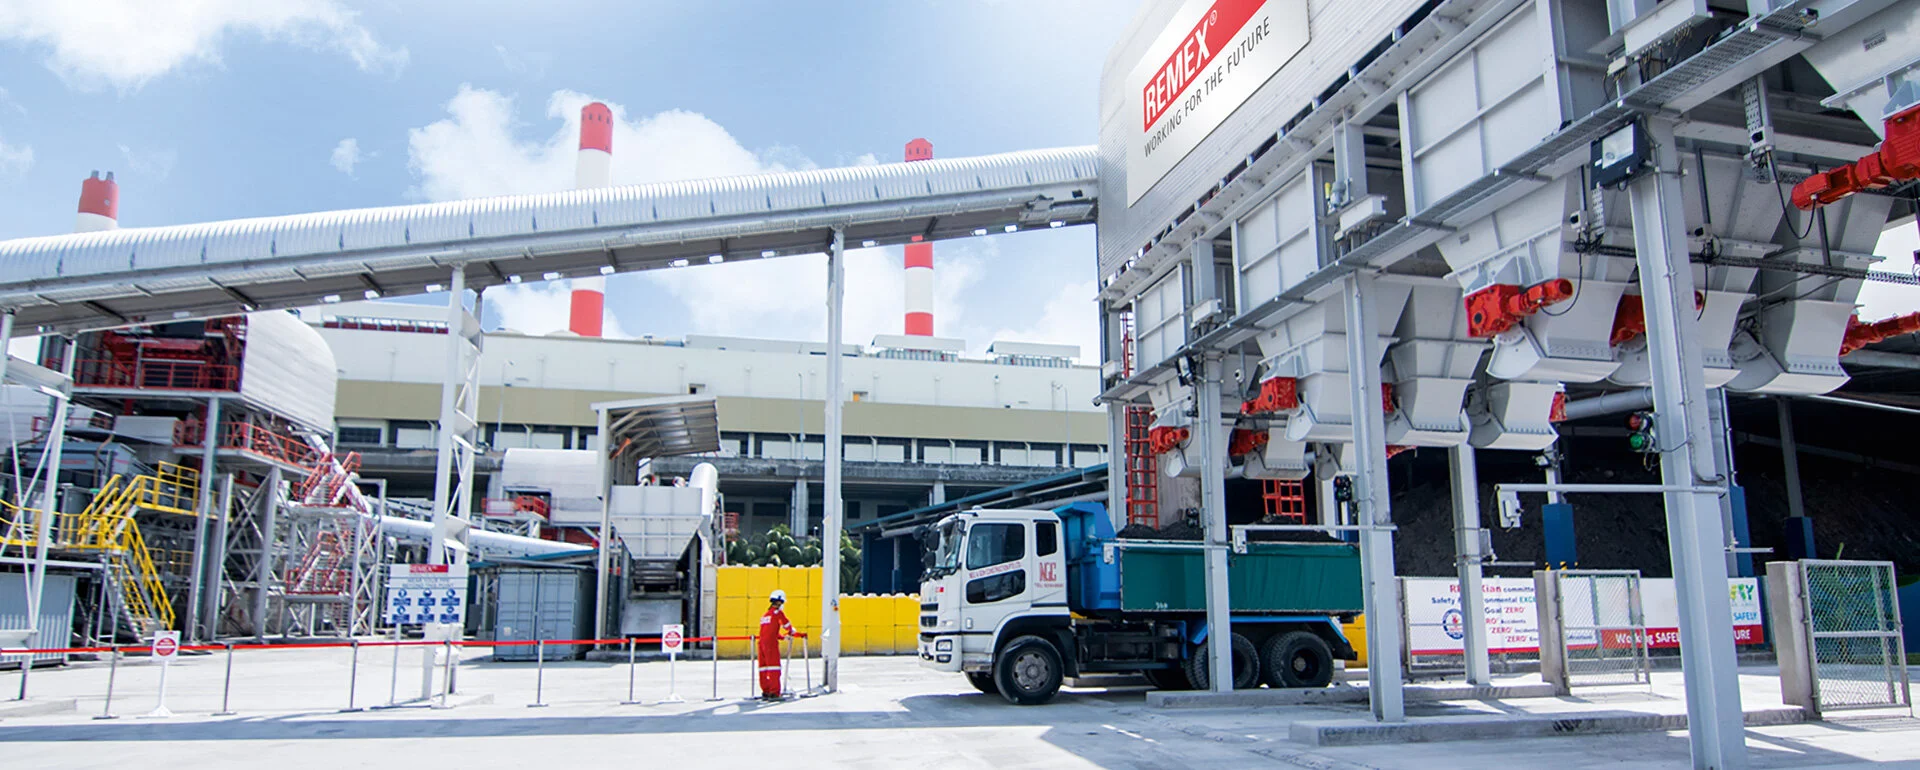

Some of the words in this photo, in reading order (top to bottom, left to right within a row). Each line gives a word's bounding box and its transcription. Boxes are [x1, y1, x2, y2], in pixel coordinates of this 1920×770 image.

[1144, 109, 1182, 158] WORKING
[1184, 88, 1202, 117] FOR
[1204, 65, 1223, 96] THE
[1227, 16, 1271, 74] FUTURE
[1039, 562, 1057, 581] NGC
[1432, 597, 1455, 605] Safety
[1734, 612, 1757, 621] SAFELY
